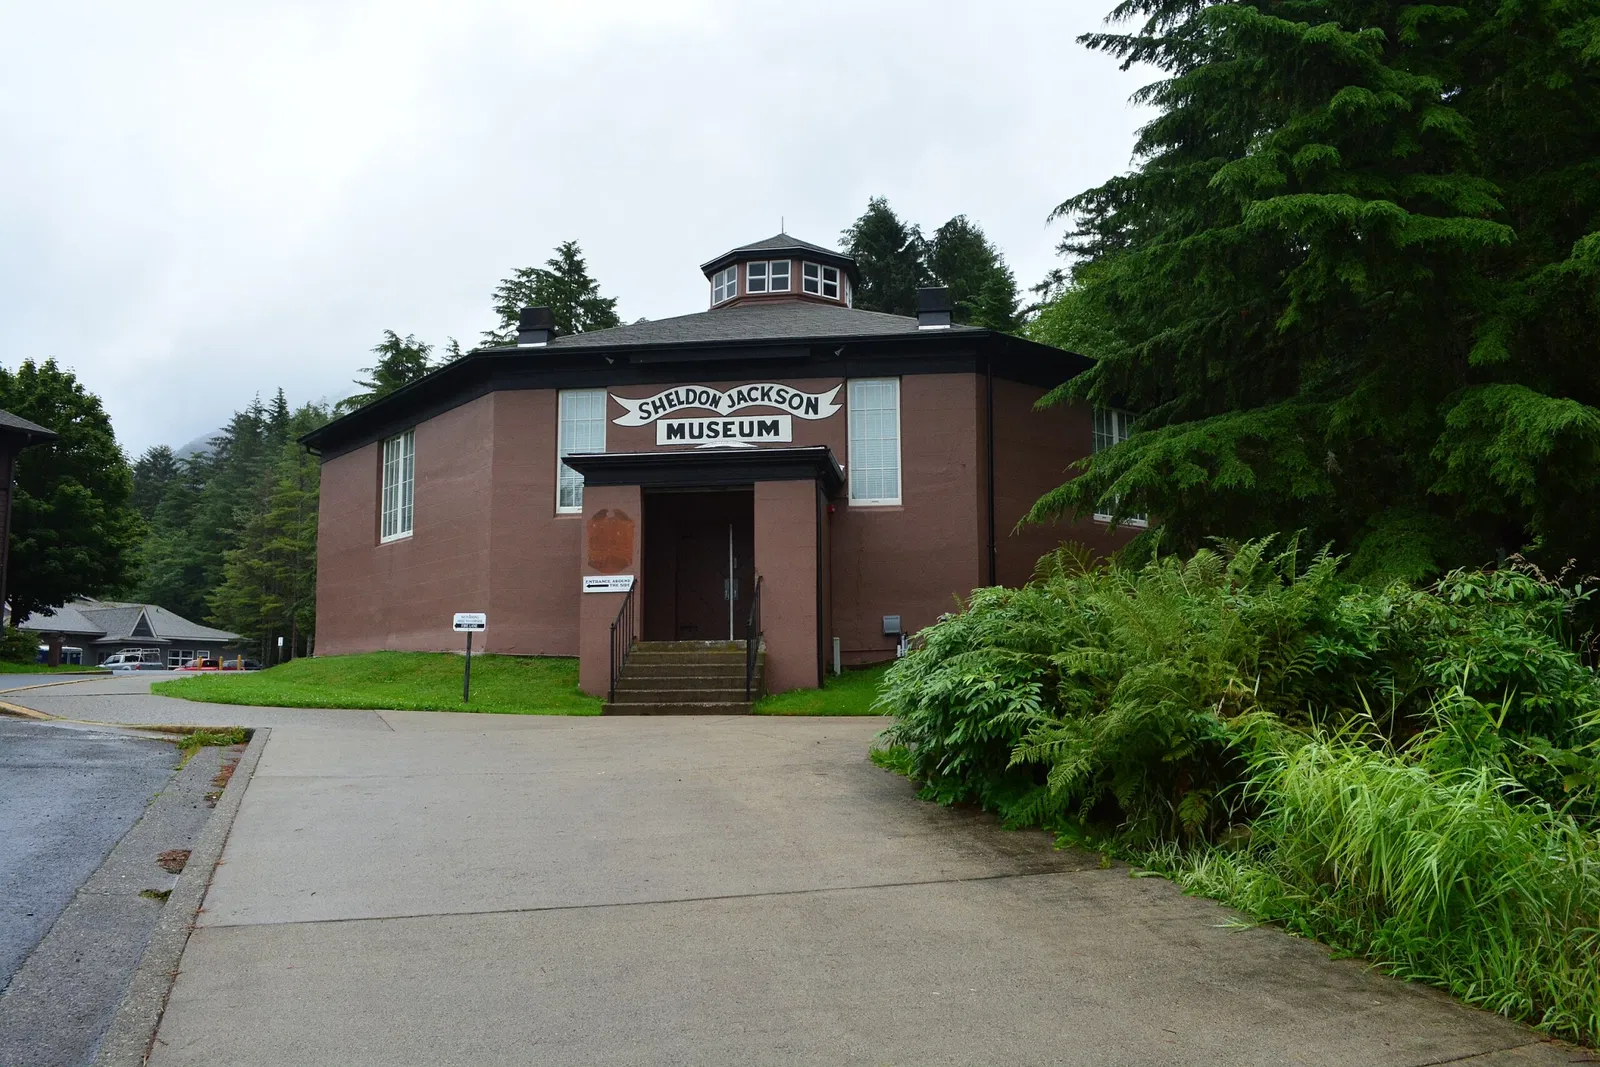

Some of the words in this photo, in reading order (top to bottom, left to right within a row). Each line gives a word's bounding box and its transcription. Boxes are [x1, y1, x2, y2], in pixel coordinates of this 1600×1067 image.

[638, 388, 722, 420] SHELDON
[727, 386, 819, 415] JACKSON
[666, 420, 780, 440] MUSEUM
